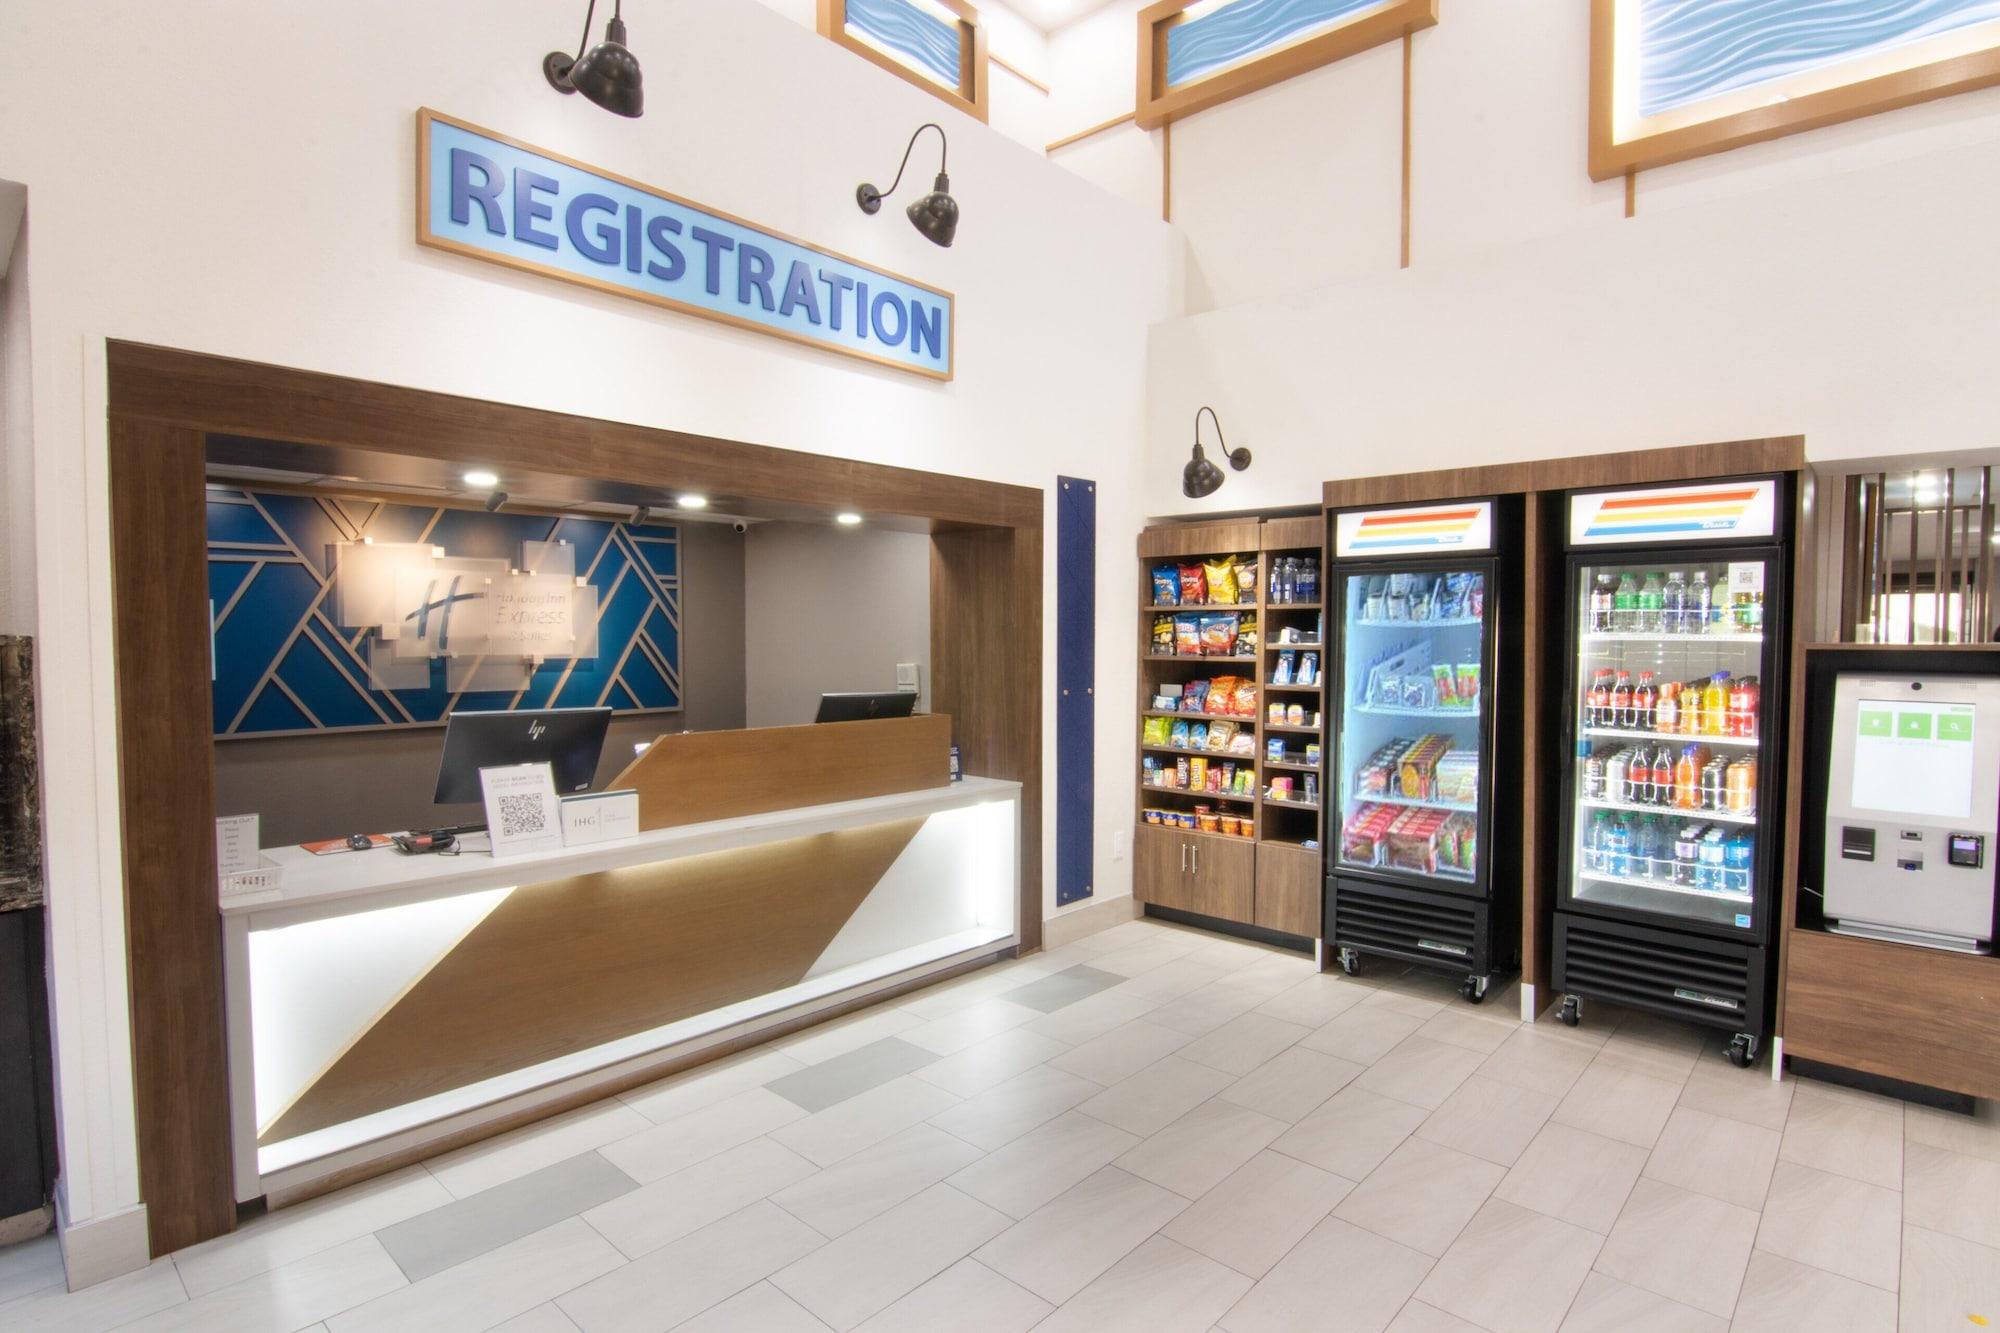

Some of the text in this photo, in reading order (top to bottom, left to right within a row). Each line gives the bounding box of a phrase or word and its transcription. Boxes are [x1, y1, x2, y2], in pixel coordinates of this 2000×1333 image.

[449, 147, 942, 359] REGISTRATION
[528, 719, 546, 741] hp
[574, 816, 596, 827] IHG
